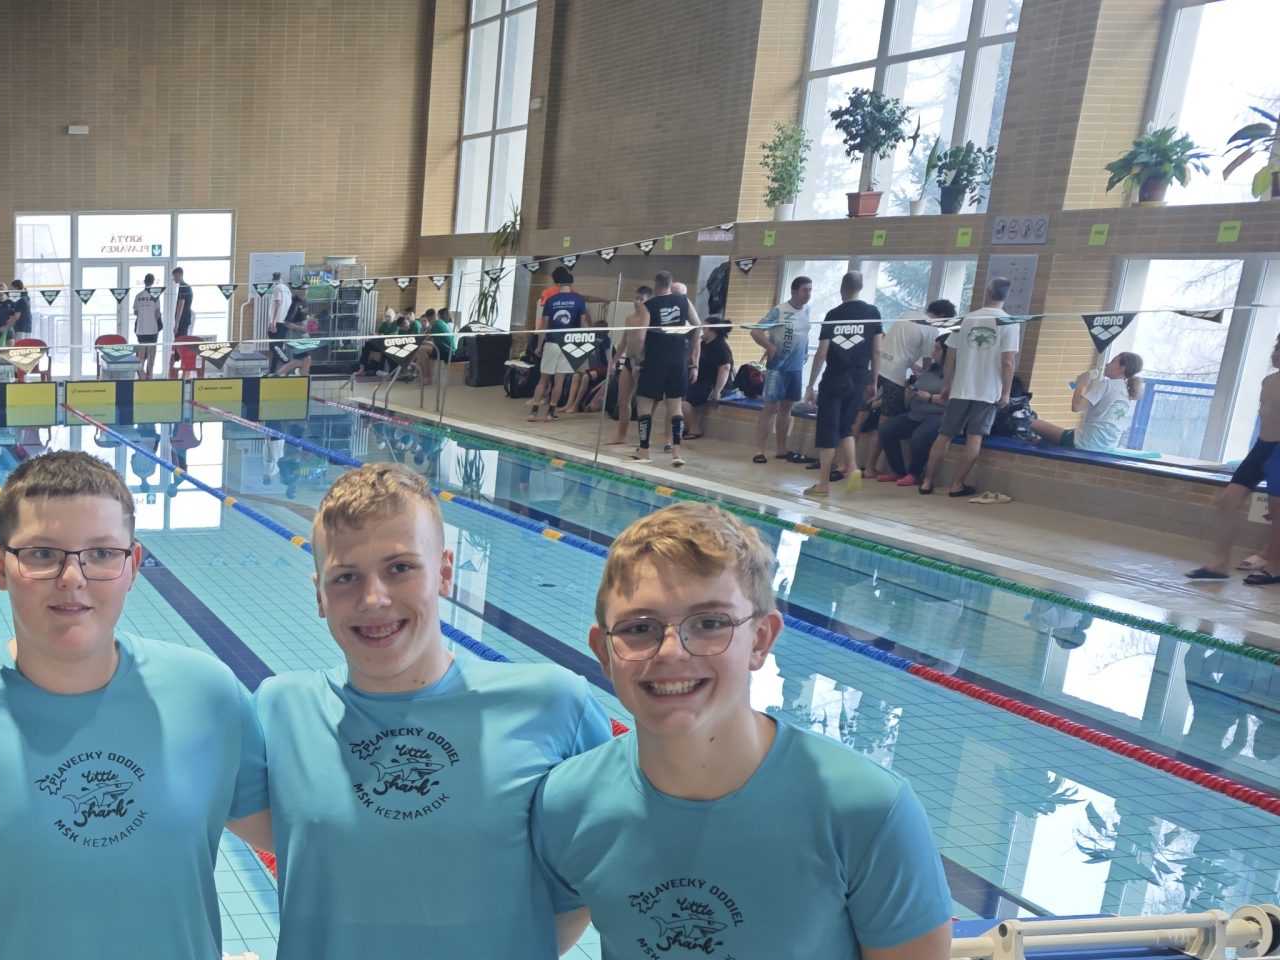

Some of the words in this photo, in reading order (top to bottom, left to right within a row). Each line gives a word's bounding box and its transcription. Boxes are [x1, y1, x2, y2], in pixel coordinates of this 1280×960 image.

[1093, 315, 1124, 326] arena
[564, 332, 596, 342] arena
[783, 311, 795, 356] NEREUS
[834, 324, 865, 335] arena
[384, 336, 416, 347] arena
[395, 744, 433, 759] little
[427, 731, 460, 767] ODDIEL
[108, 752, 146, 782] ODDIEL
[81, 770, 118, 784] little
[676, 897, 715, 916] little
[709, 885, 744, 928] ODDIEL
